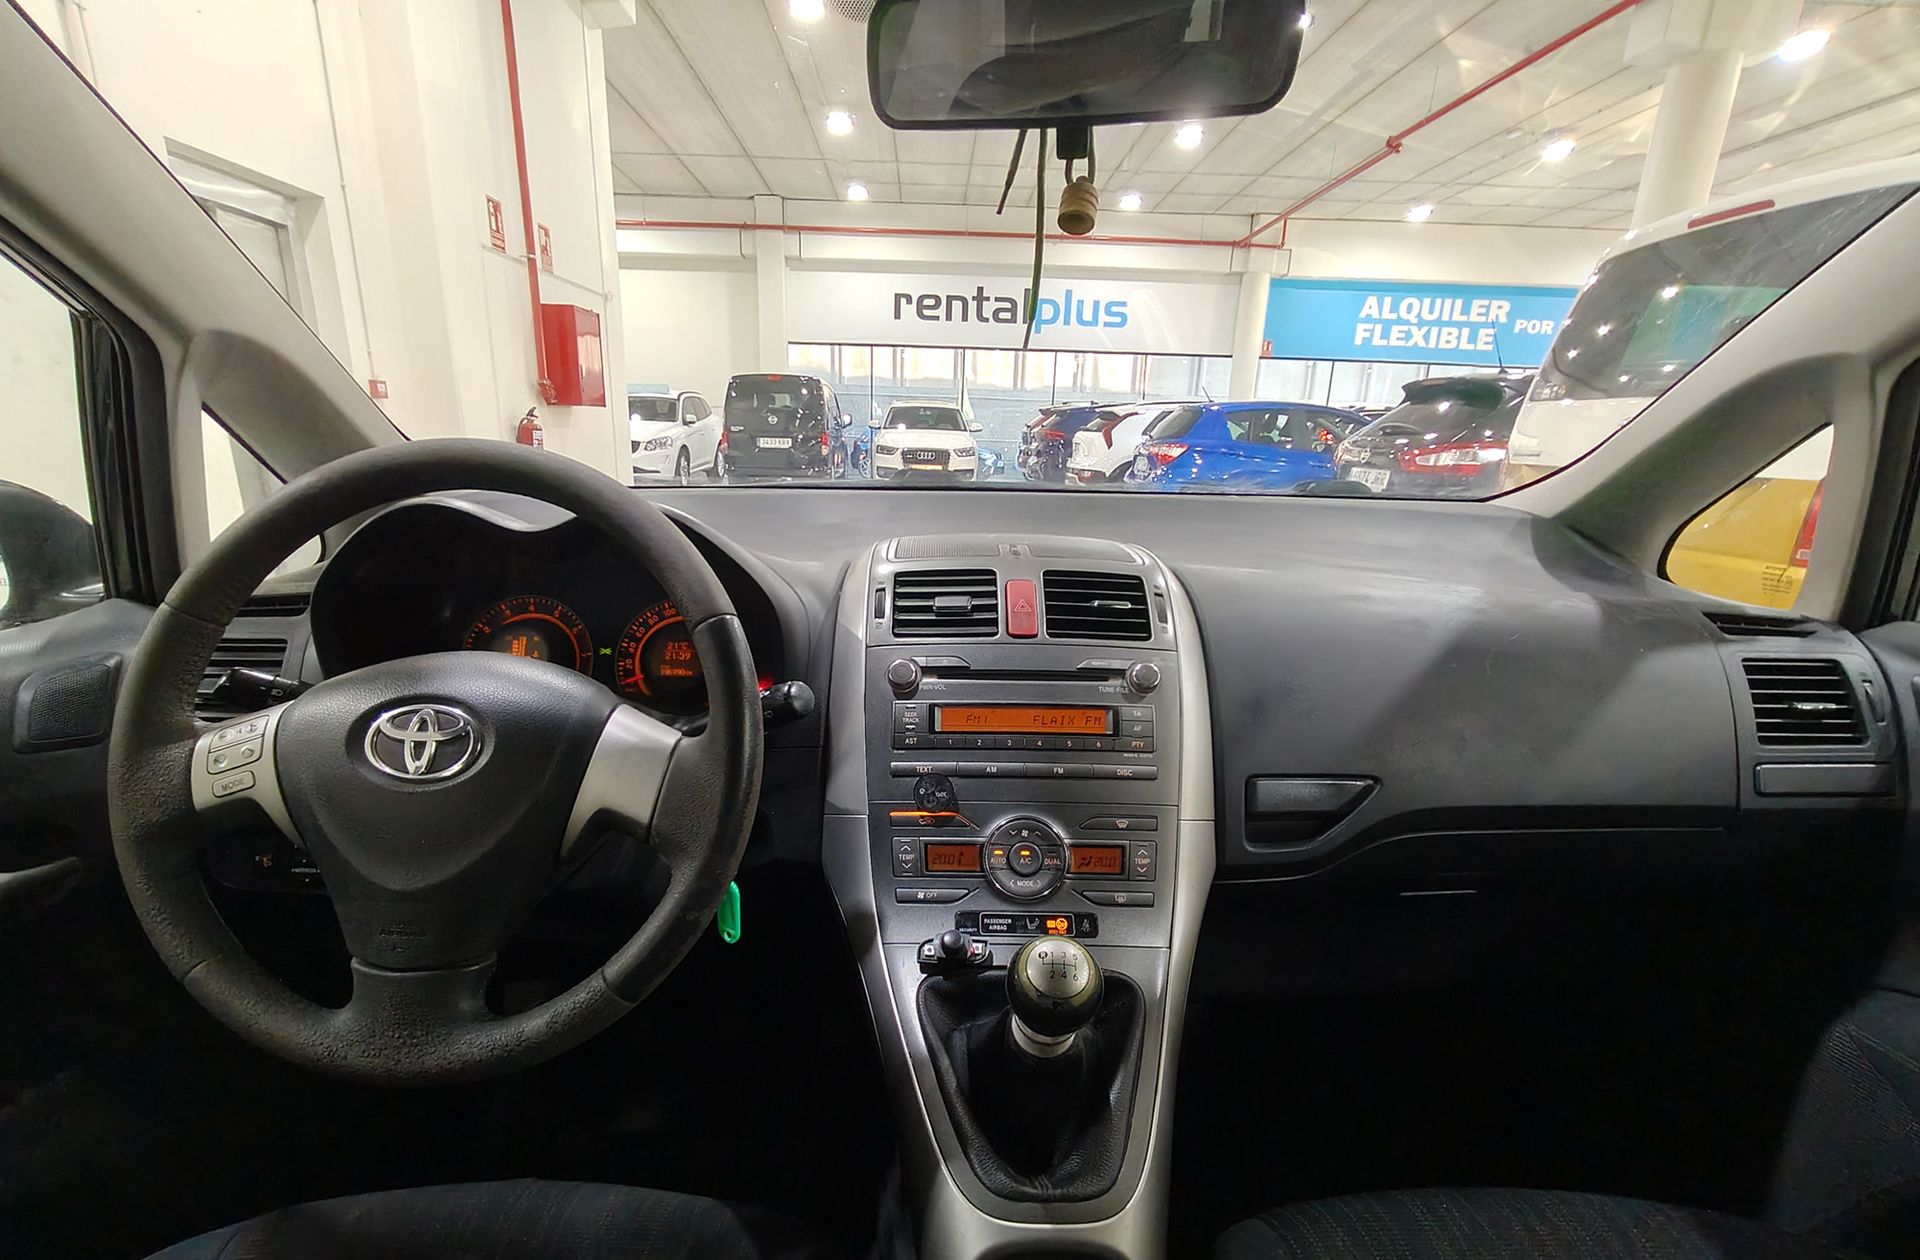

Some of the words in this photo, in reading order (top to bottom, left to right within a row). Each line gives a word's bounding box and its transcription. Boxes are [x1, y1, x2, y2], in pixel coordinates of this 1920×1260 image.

[1359, 296, 1511, 323] ALQUILER
[1514, 319, 1555, 335] POR
[1354, 323, 1497, 350] FLEXIBLE
[1033, 715, 1076, 725] FLAIX
[1085, 716, 1102, 725] FM
[221, 778, 245, 791] MODE
[1050, 970, 1056, 979] 2
[1061, 970, 1067, 979] 4
[1073, 973, 1079, 981] 6
